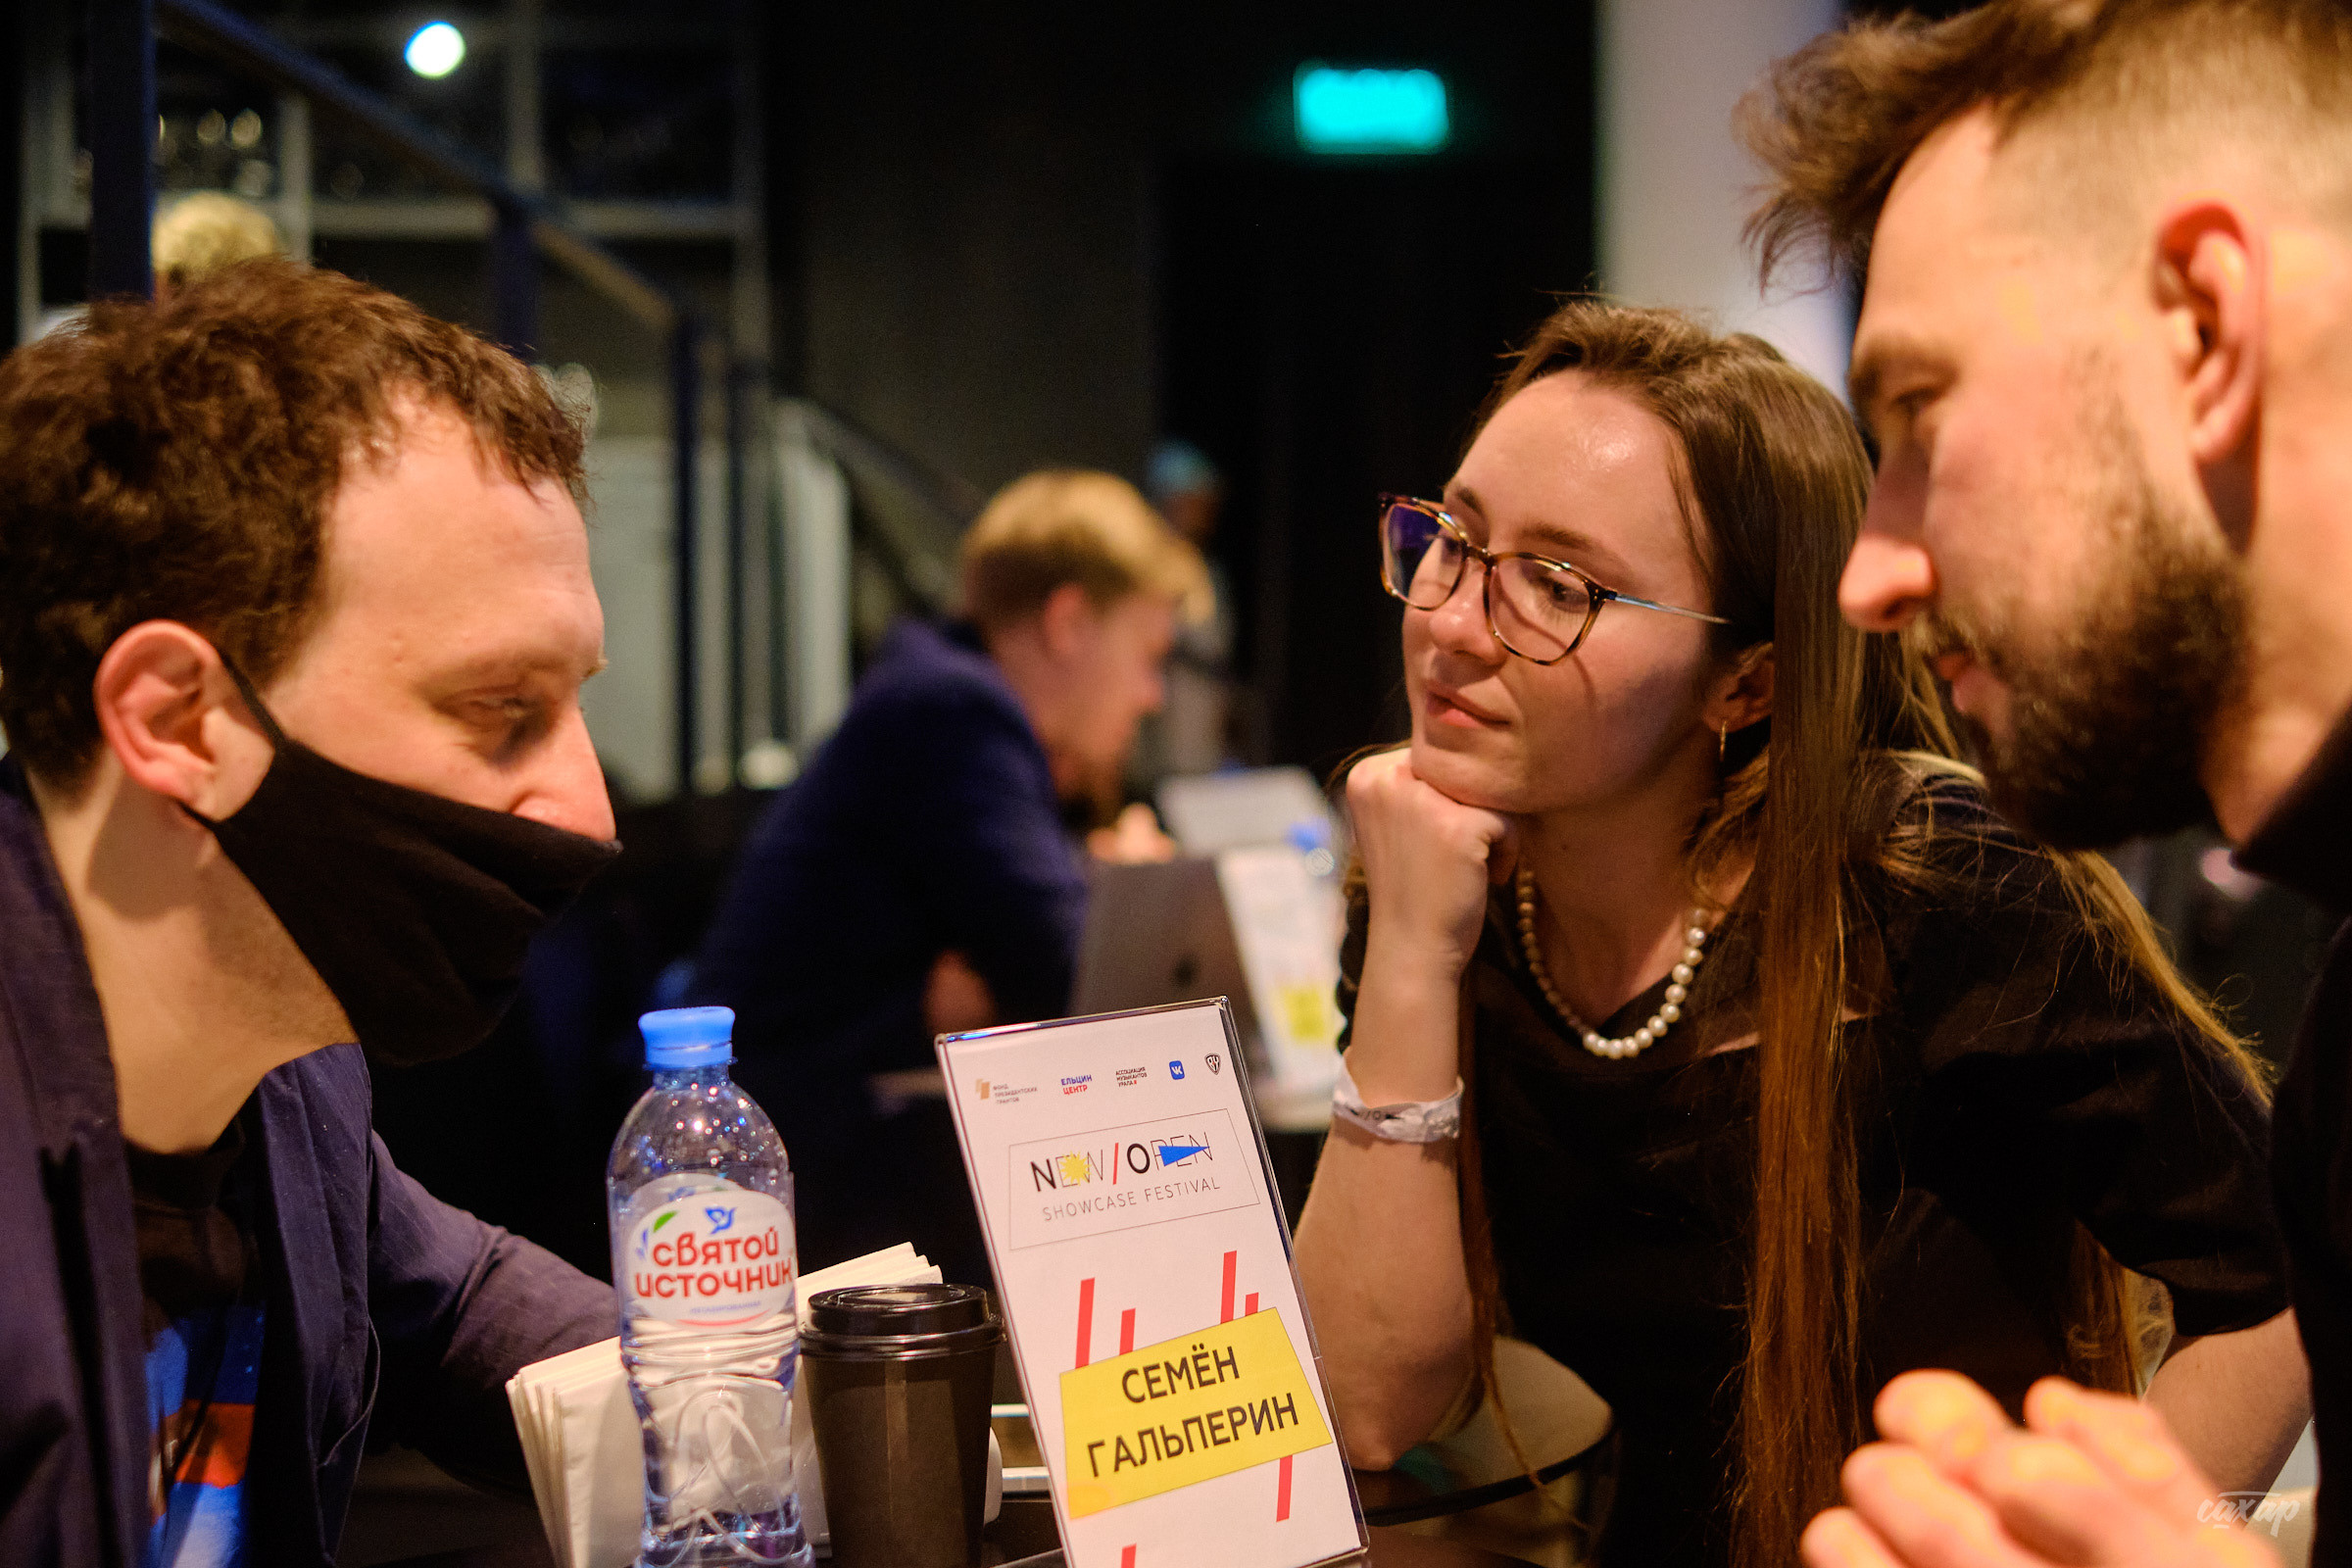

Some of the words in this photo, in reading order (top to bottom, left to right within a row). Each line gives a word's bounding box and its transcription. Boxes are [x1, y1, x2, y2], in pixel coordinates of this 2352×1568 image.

[1060, 1074, 1093, 1086] ЕЛЬЦИН
[1062, 1084, 1088, 1096] ЦЕНТР
[1042, 1191, 1137, 1221] SHOWCASE
[1144, 1176, 1221, 1202] FESTIVAL
[1122, 1343, 1240, 1403] СЕМЁН
[1087, 1393, 1299, 1478] ГАЛЬПЕРИН
